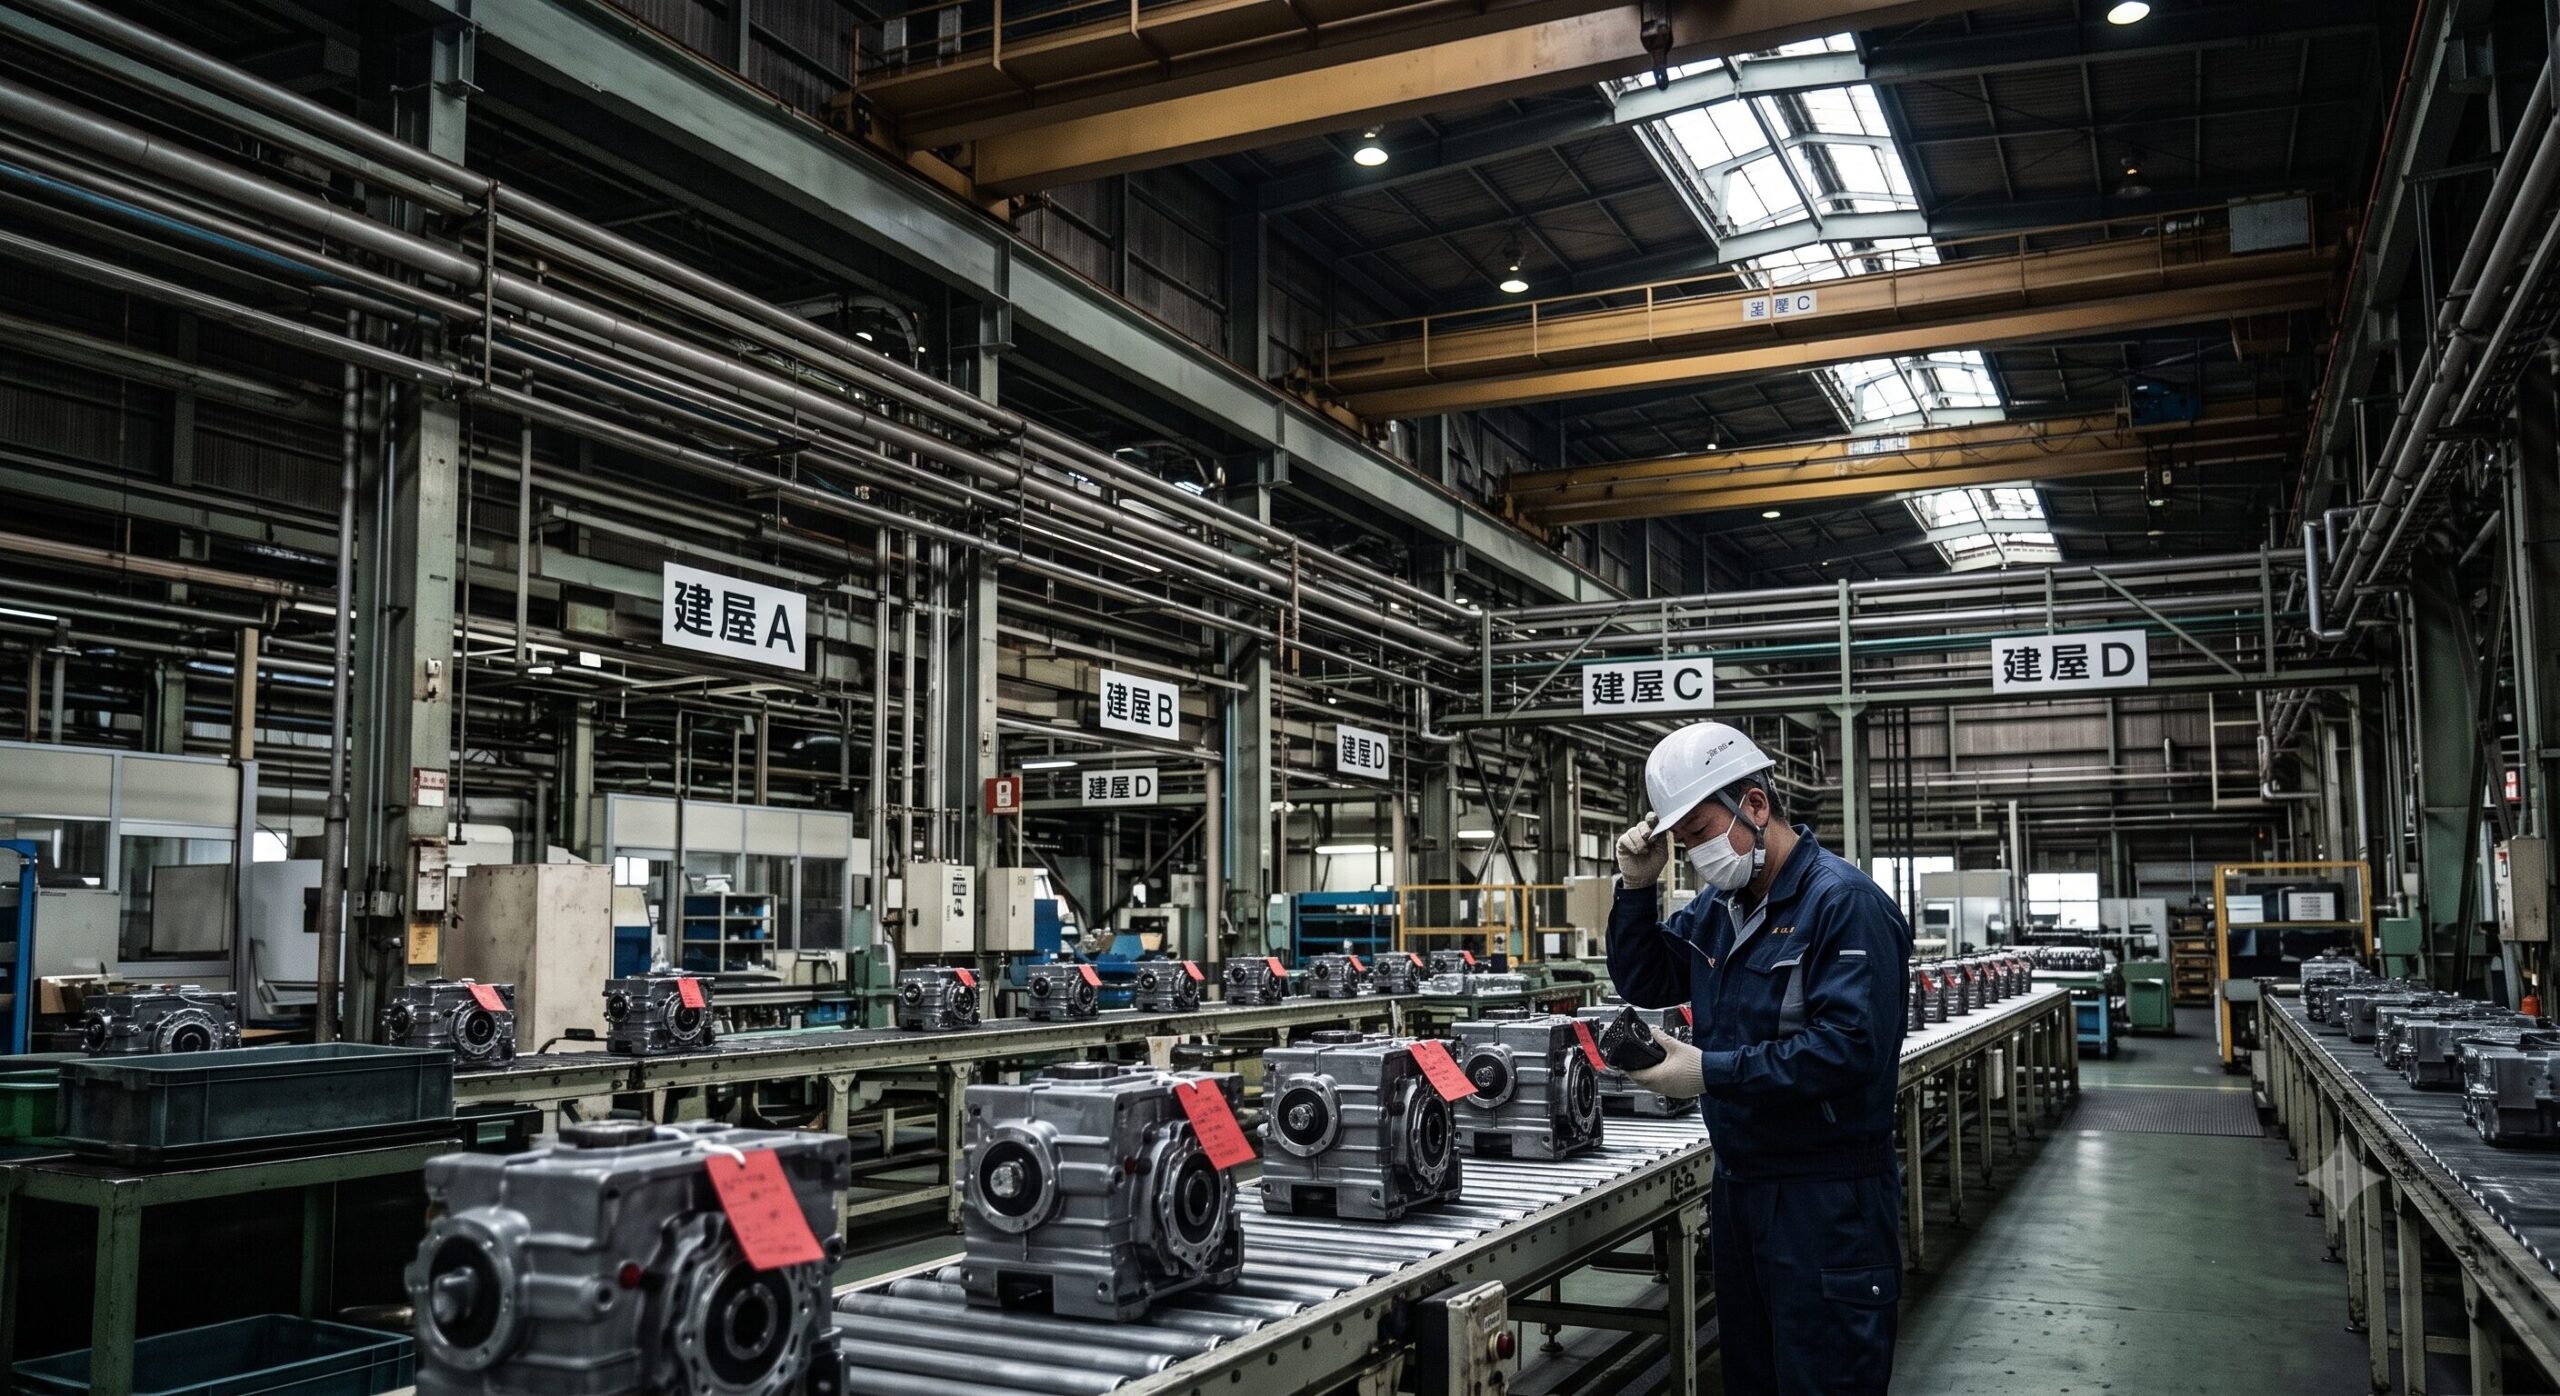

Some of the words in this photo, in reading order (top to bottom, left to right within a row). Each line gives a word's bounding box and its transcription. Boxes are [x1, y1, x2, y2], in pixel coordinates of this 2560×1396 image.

[674, 581, 796, 654] 建屋A
[2002, 641, 2136, 684] 建屋D
[1106, 681, 1173, 728] 建屋B
[1591, 667, 1703, 706] 建屋C
[1341, 735, 1385, 770] 建屋D
[1088, 775, 1151, 801] 建屋D
